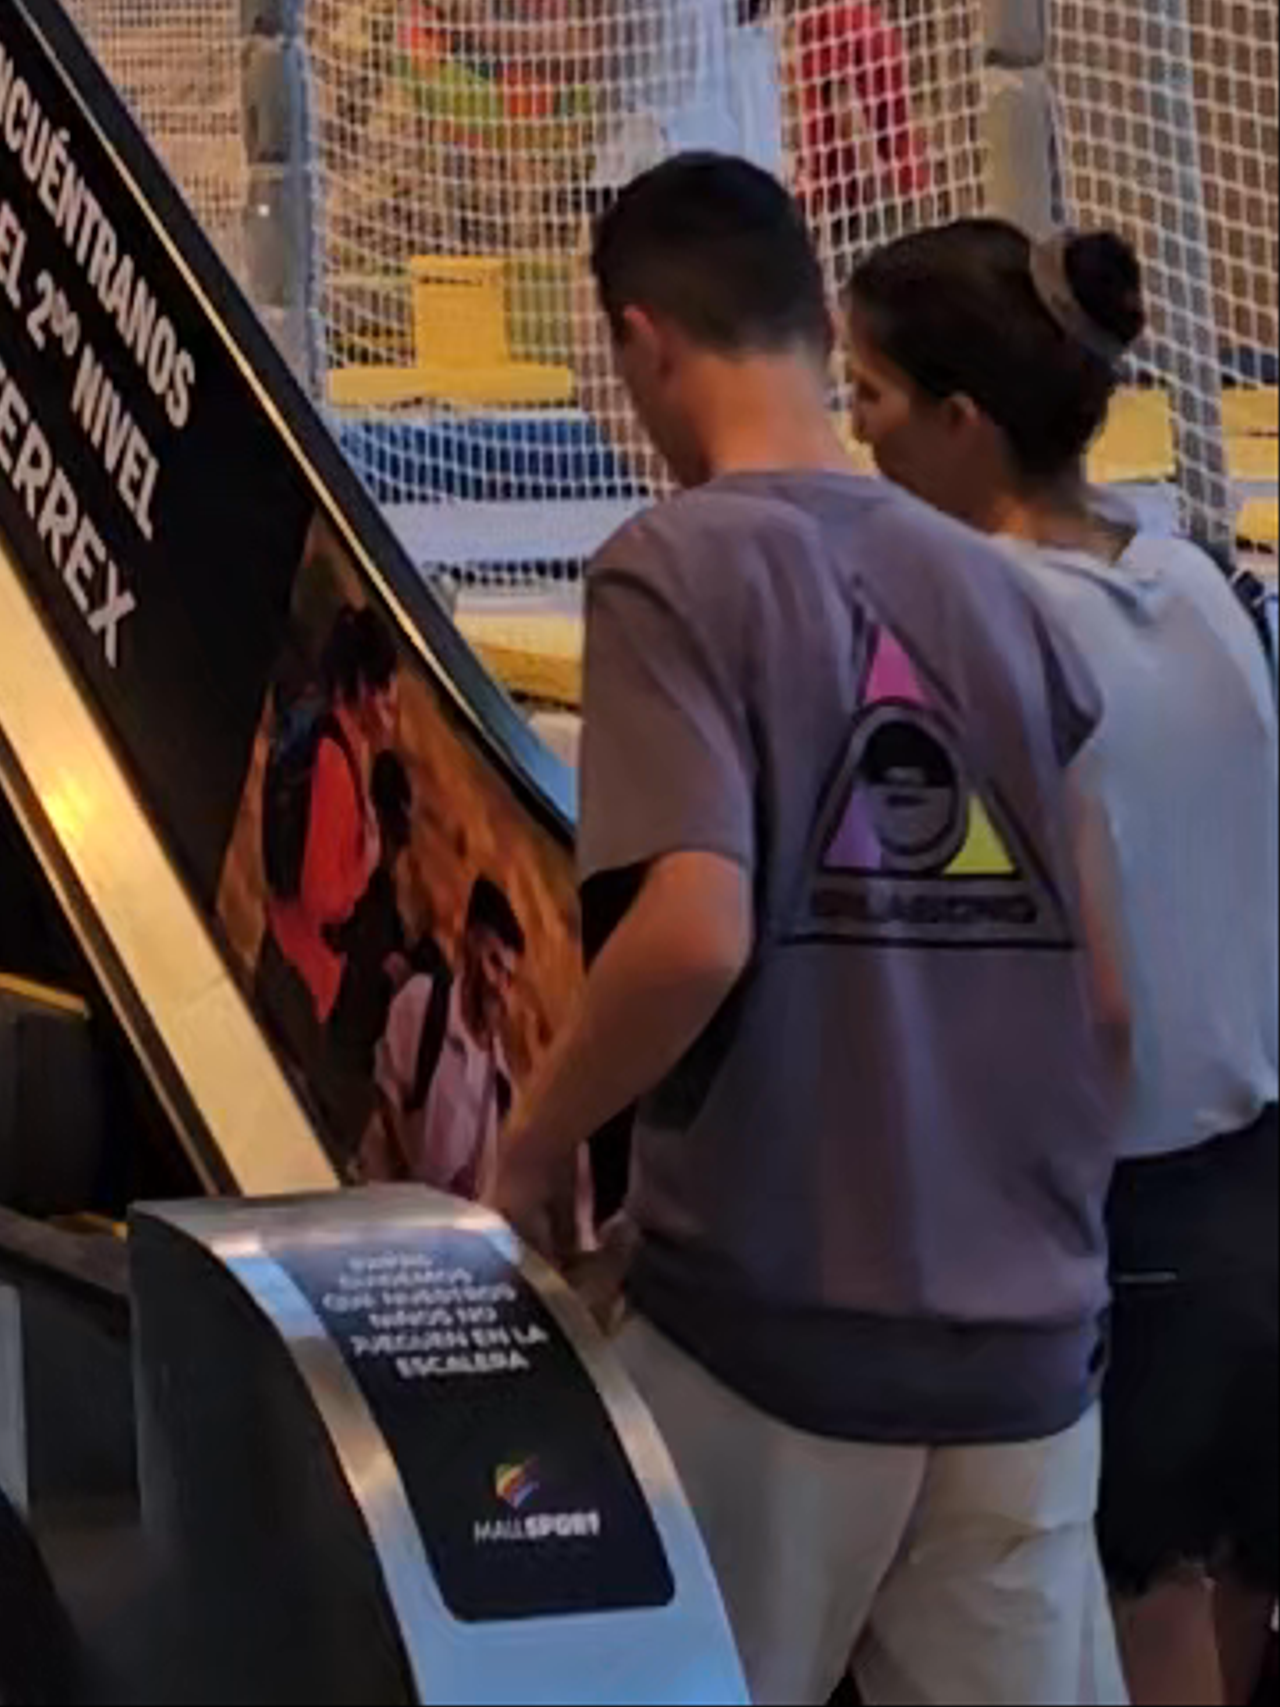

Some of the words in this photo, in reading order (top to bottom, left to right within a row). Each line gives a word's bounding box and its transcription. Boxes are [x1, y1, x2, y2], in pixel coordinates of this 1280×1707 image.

[72, 343, 160, 542] NIVEL
[349, 1329, 469, 1357] JUEGUEN
[472, 1327, 510, 1348] EN
[513, 1323, 549, 1345] LA
[396, 1350, 529, 1379] ESCALERA
[473, 1511, 600, 1544] MALLSPORT
